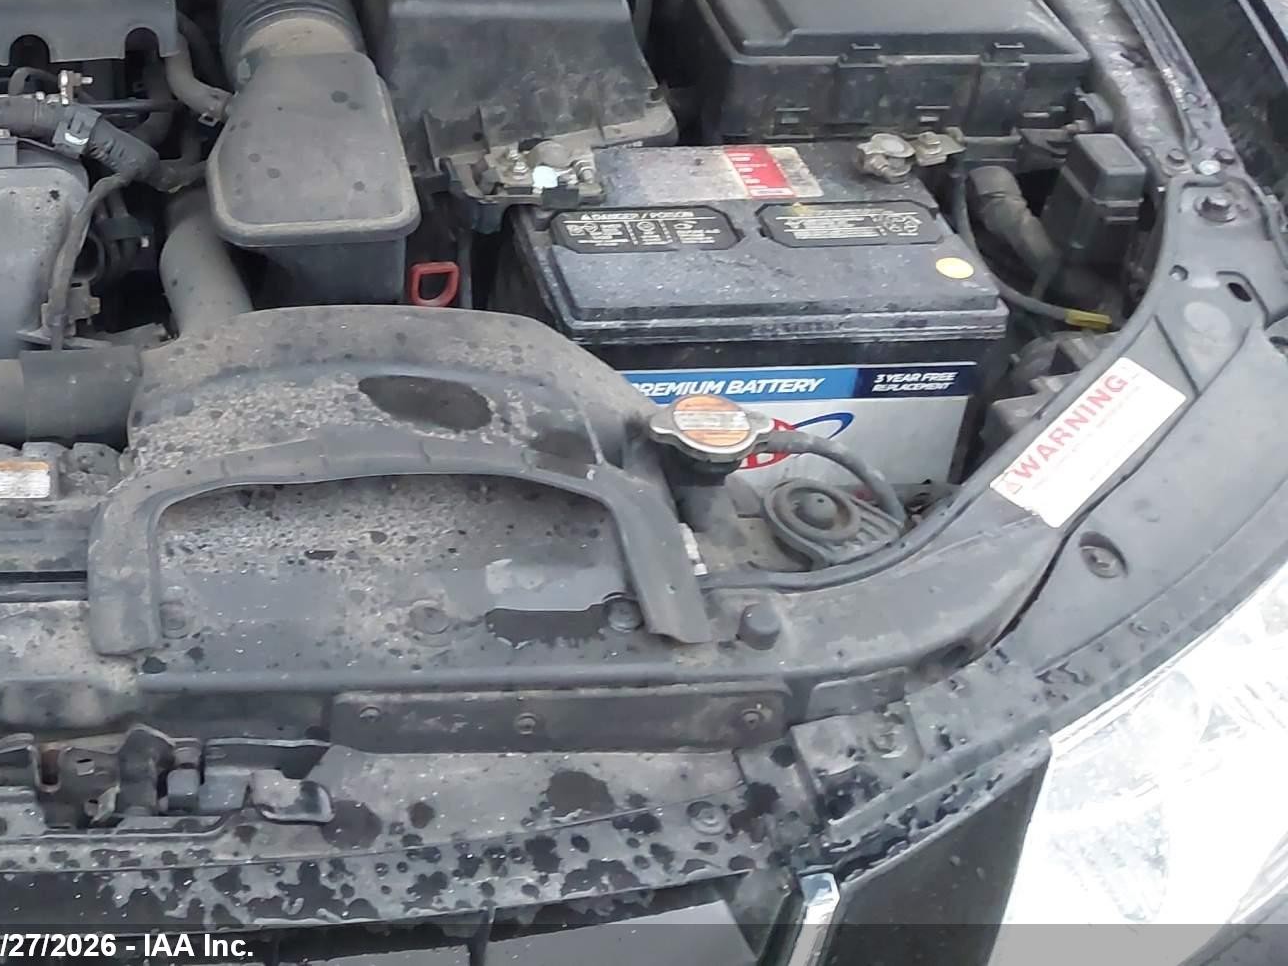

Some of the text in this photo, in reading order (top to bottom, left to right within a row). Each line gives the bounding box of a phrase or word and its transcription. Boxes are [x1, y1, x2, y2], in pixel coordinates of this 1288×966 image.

[874, 371, 958, 383] 3 YEAR FREE
[725, 377, 825, 396] BATTERY
[872, 382, 954, 391] REPLACEMENT
[1014, 374, 1128, 480] WARNING
